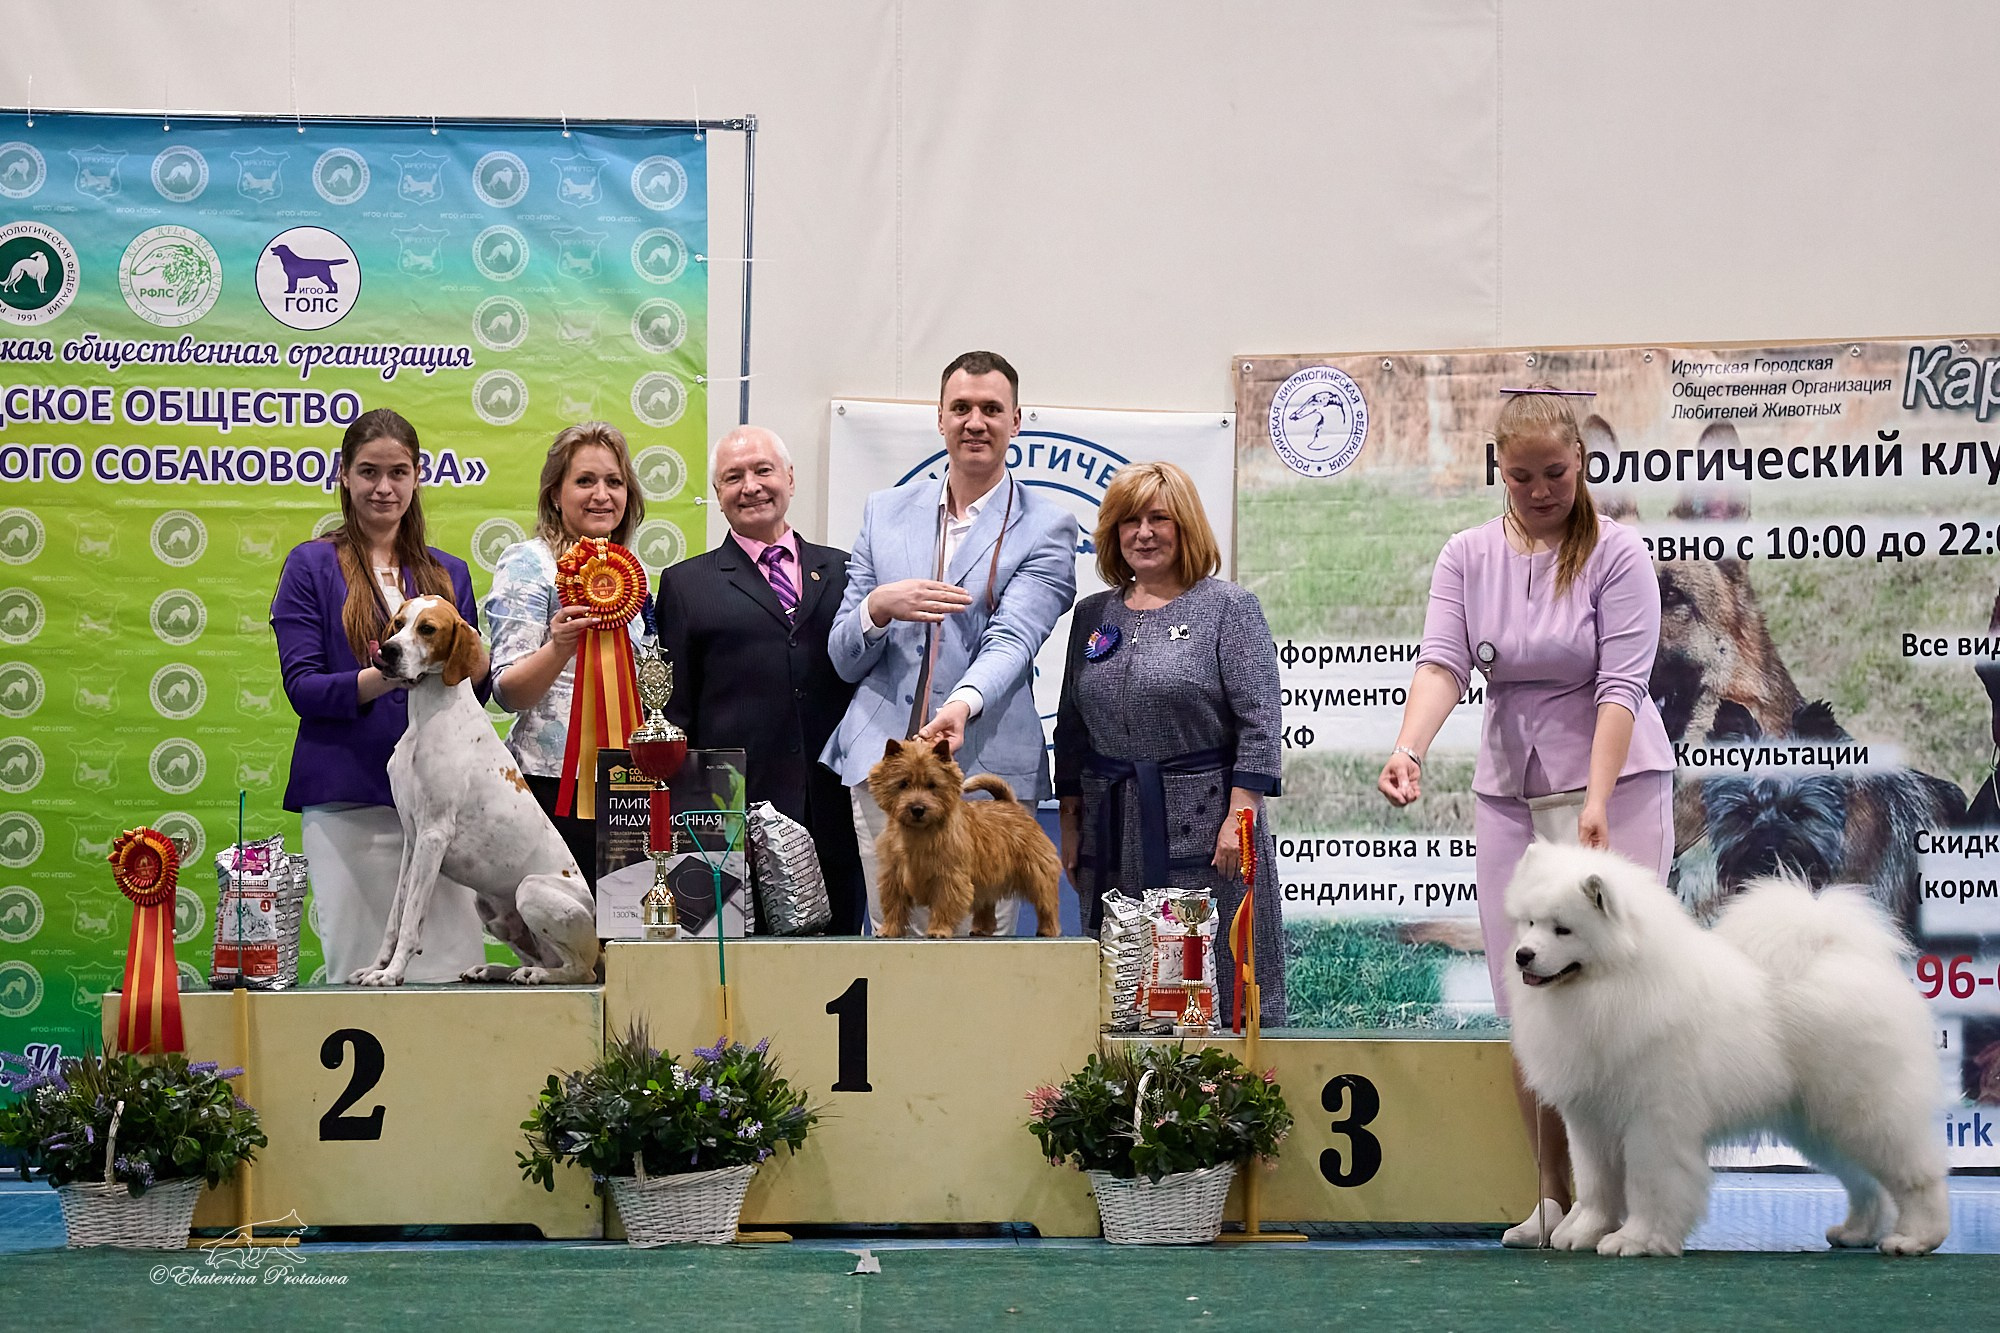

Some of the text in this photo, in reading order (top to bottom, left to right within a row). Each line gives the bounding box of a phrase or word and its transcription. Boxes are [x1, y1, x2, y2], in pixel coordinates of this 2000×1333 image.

[47, 261, 76, 315] ФЕДЕРАЦИЯ
[140, 288, 174, 298] РФЛС
[299, 287, 324, 295] ИГОО
[285, 297, 338, 312] ГОЛС
[63, 335, 279, 370] общественная
[288, 344, 474, 379] организация
[1671, 357, 1833, 377] Иркутская Городская
[1672, 378, 1892, 400] Общественная Организация
[1903, 346, 2000, 422] Кар
[0, 389, 359, 430] СКОЕ ОБЩЕСТВО
[1272, 370, 1365, 472] РОССИЙСКАЯ КИНОЛОГИЧЕСКАЯ ФЕДЕРАЦИЯ
[1671, 401, 1842, 419] Любителей Животных
[1922, 441, 2000, 485] клу
[1737, 535, 1754, 561] с
[1766, 525, 1866, 561] 10:00
[1877, 531, 1926, 562] до
[1939, 522, 2000, 556] 22:
[1273, 640, 1420, 669] формлени
[1902, 633, 1949, 657] Все
[1674, 743, 1869, 772] Консультации
[1427, 839, 1441, 857] к
[1913, 830, 1999, 859] Скидк
[1280, 883, 1478, 908] ендлинг, грум
[1917, 873, 1998, 905] (корм
[1917, 954, 2000, 999] 96-
[826, 978, 872, 1092] 1
[319, 1028, 387, 1142] 2
[1319, 1074, 1382, 1188] 3
